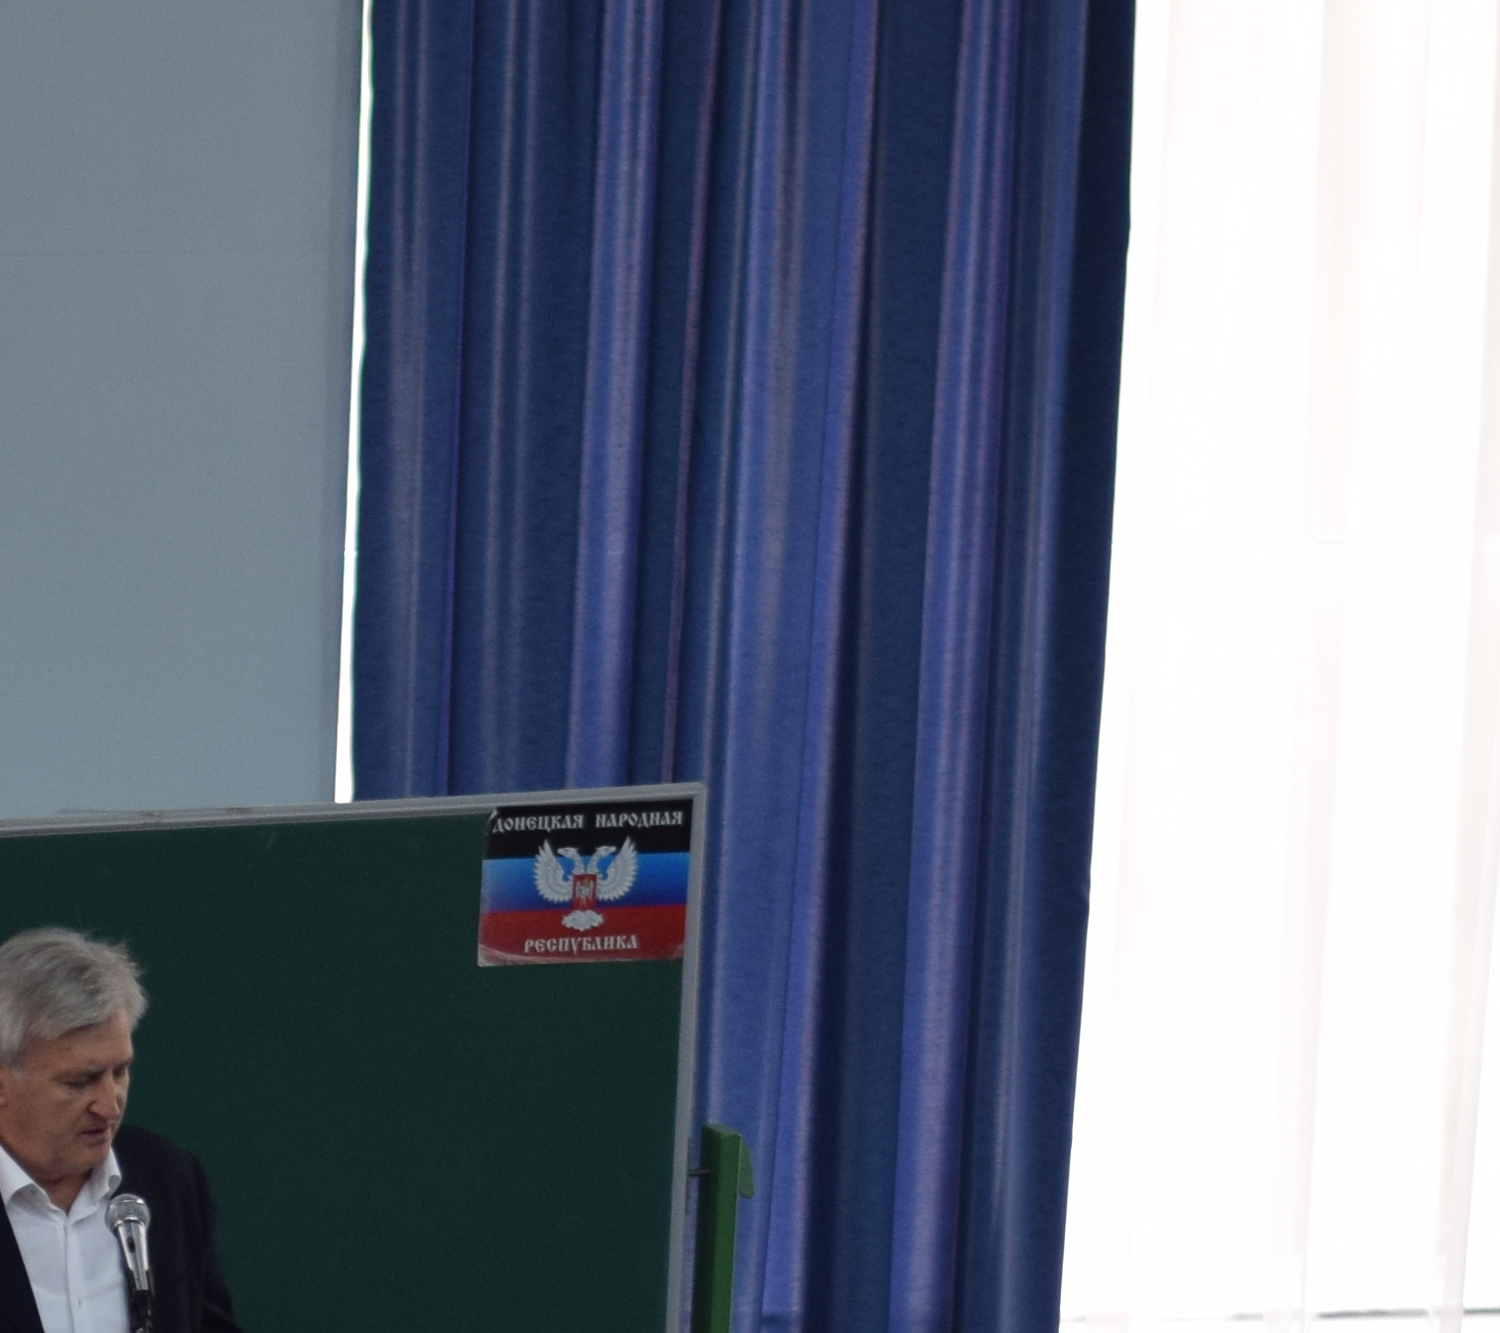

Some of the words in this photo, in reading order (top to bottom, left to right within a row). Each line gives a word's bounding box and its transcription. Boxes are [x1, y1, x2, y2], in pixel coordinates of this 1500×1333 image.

[492, 813, 584, 834] ДОНЕЦКАЯ
[595, 811, 683, 829] НАРОДНАЯ
[524, 935, 638, 954] РЕСПУБЛИКА
